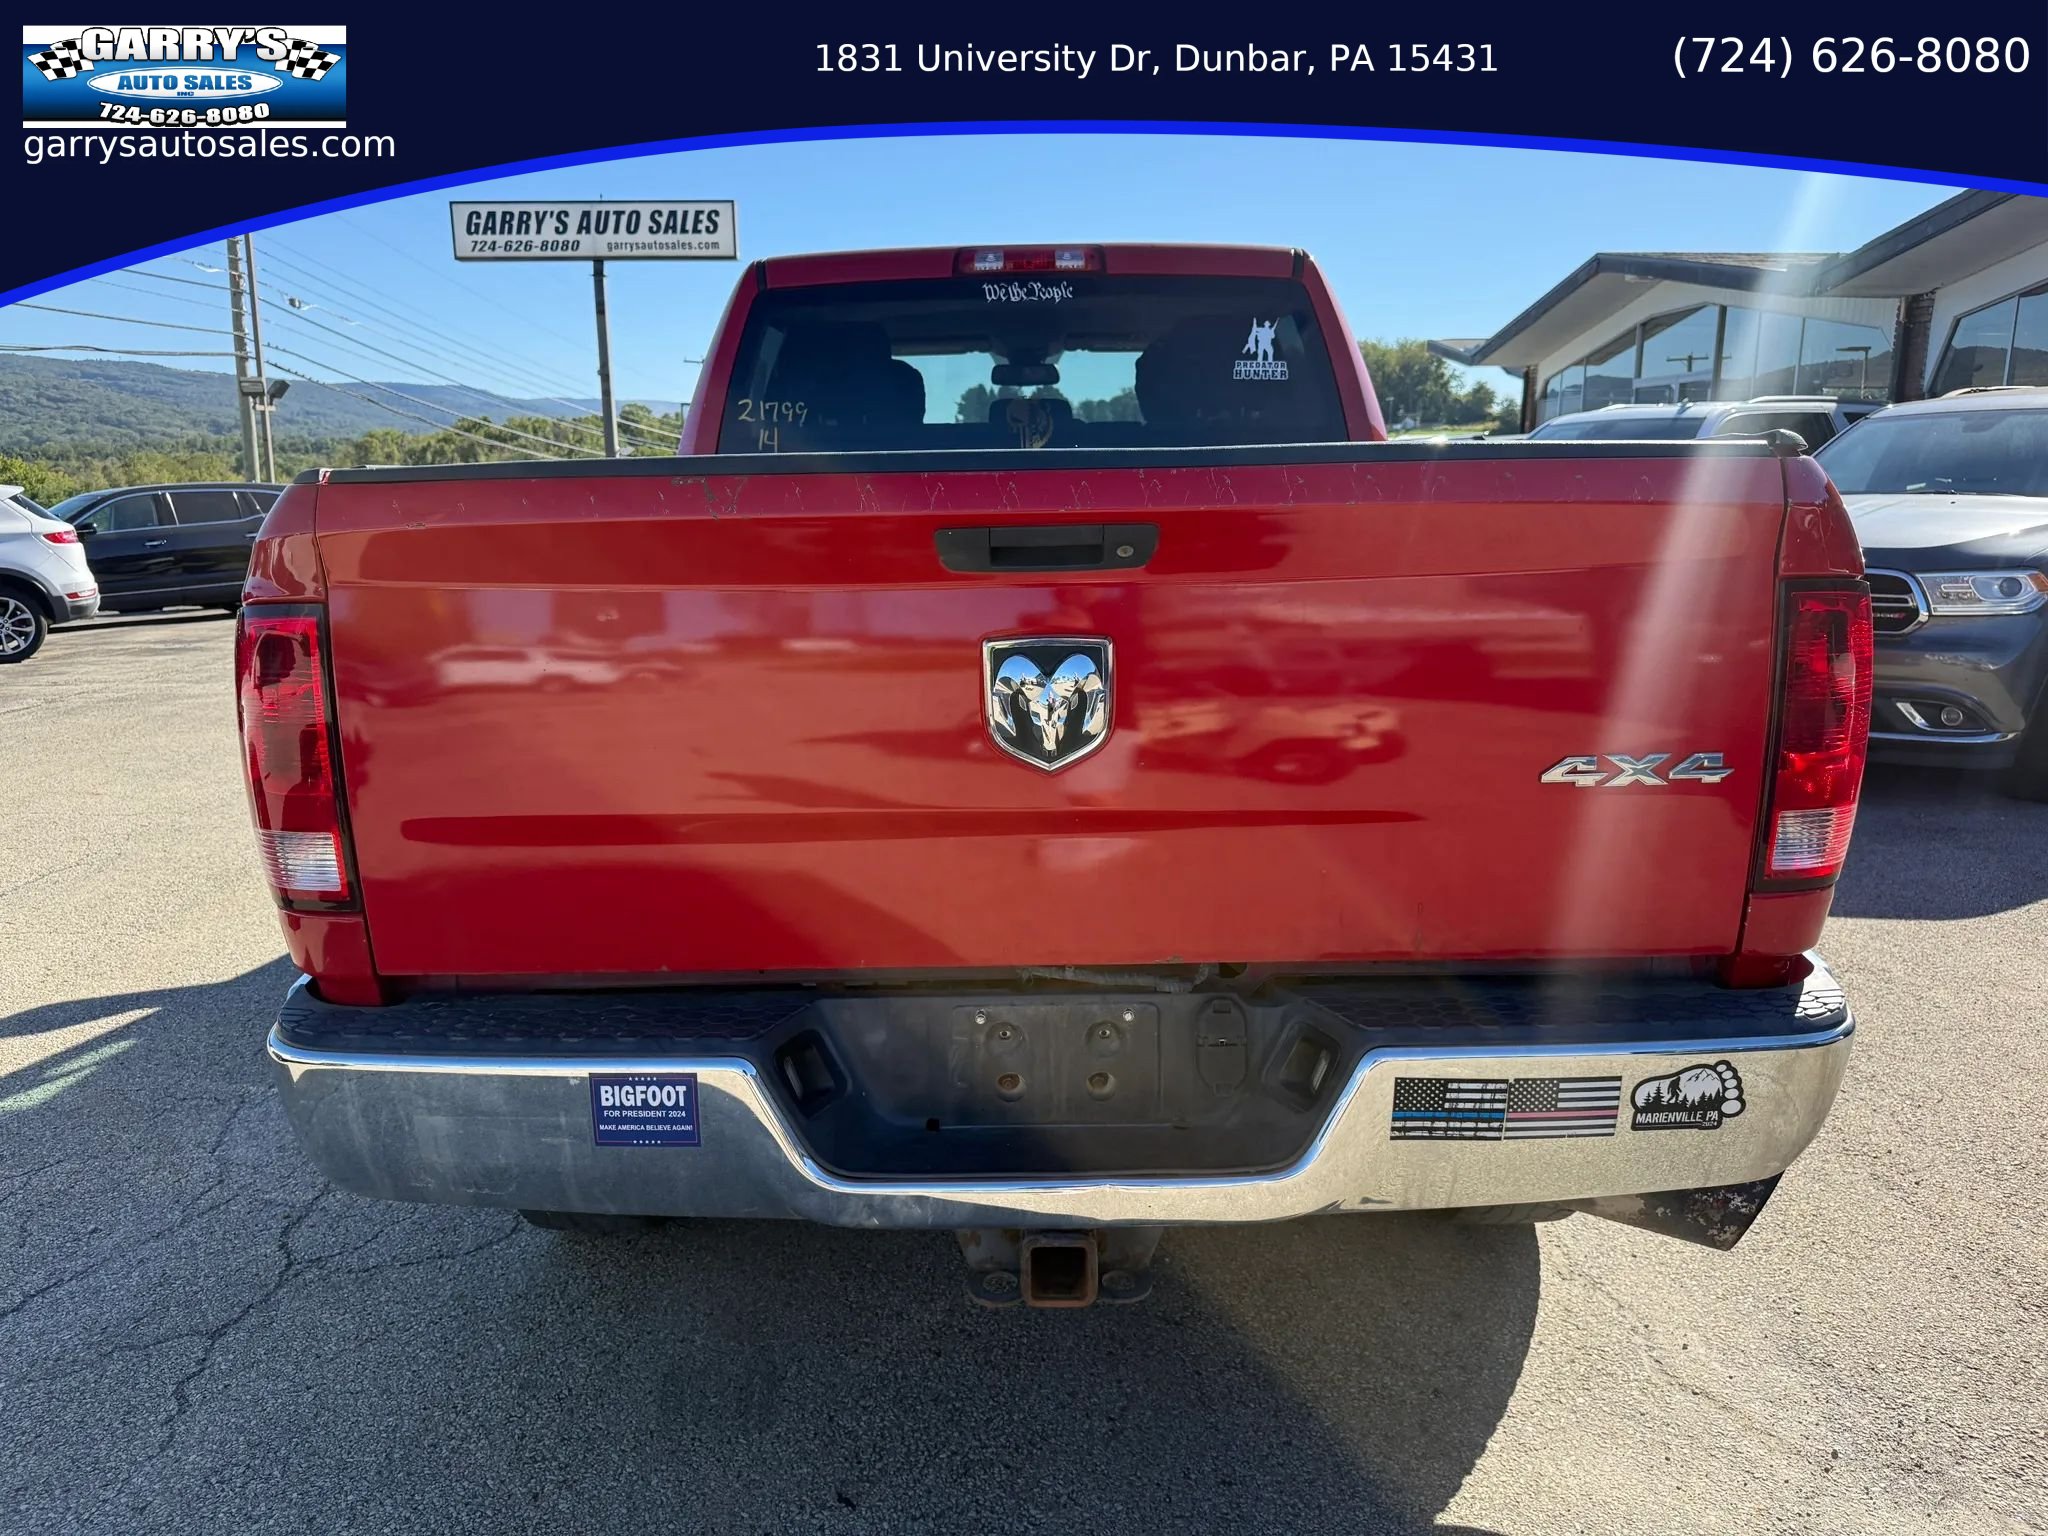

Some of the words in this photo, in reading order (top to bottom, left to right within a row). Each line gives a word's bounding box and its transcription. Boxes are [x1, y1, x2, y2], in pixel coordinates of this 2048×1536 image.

[465, 210, 570, 236] GARRY'S
[576, 209, 641, 235] AUTO
[648, 209, 721, 235] SALES
[470, 239, 581, 253] 724-626-8080
[606, 239, 720, 253] garrysautosales.com
[982, 282, 1009, 303] We
[1026, 281, 1073, 304] People
[1234, 369, 1288, 379] HUNTER
[1236, 361, 1287, 369] PREDATOR
[738, 399, 808, 427] 21799
[759, 427, 778, 453] 14
[600, 1085, 686, 1107] BIGFOOT
[604, 1110, 621, 1118] FOR
[622, 1110, 666, 1118] PRESIDENT
[668, 1110, 686, 1118] 2024
[1636, 1111, 1703, 1124] MARIENVILLE
[1706, 1110, 1719, 1121] PA
